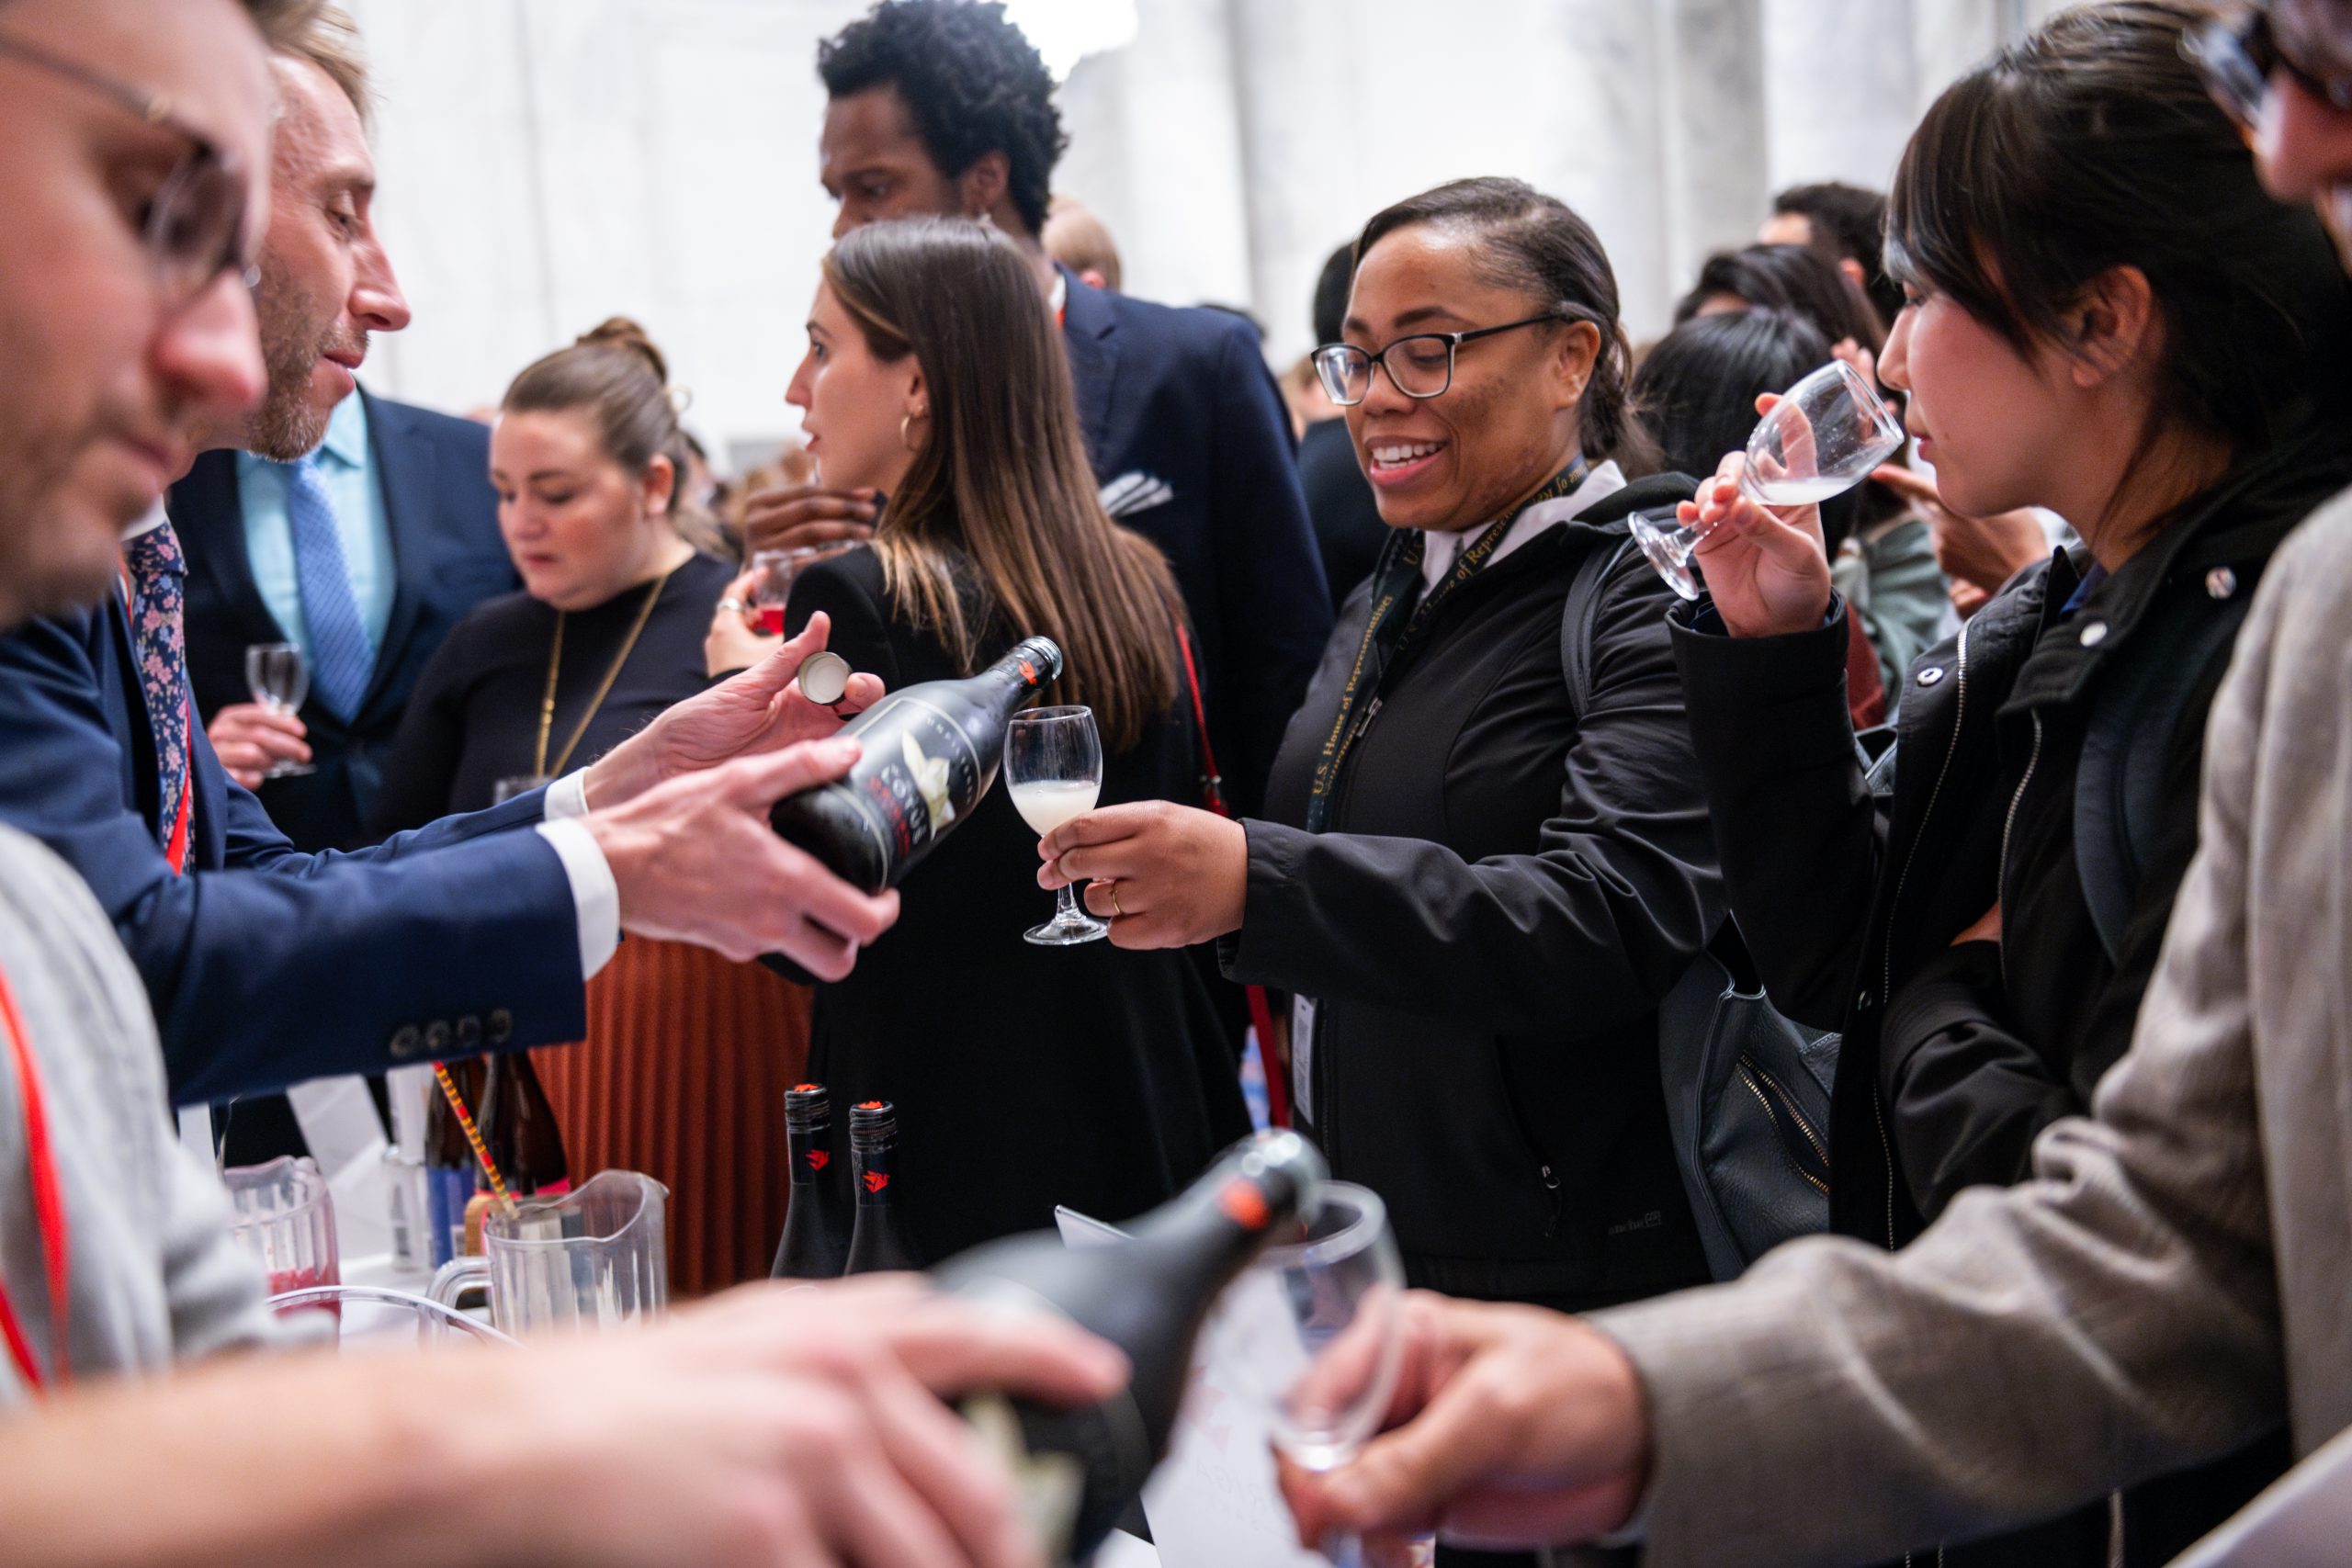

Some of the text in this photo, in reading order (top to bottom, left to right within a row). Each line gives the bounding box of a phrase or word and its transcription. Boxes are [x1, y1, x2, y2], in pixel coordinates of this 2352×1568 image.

[1456, 558, 1475, 580] of
[1323, 714, 1345, 755] House
[1345, 595, 1393, 692] Representatives
